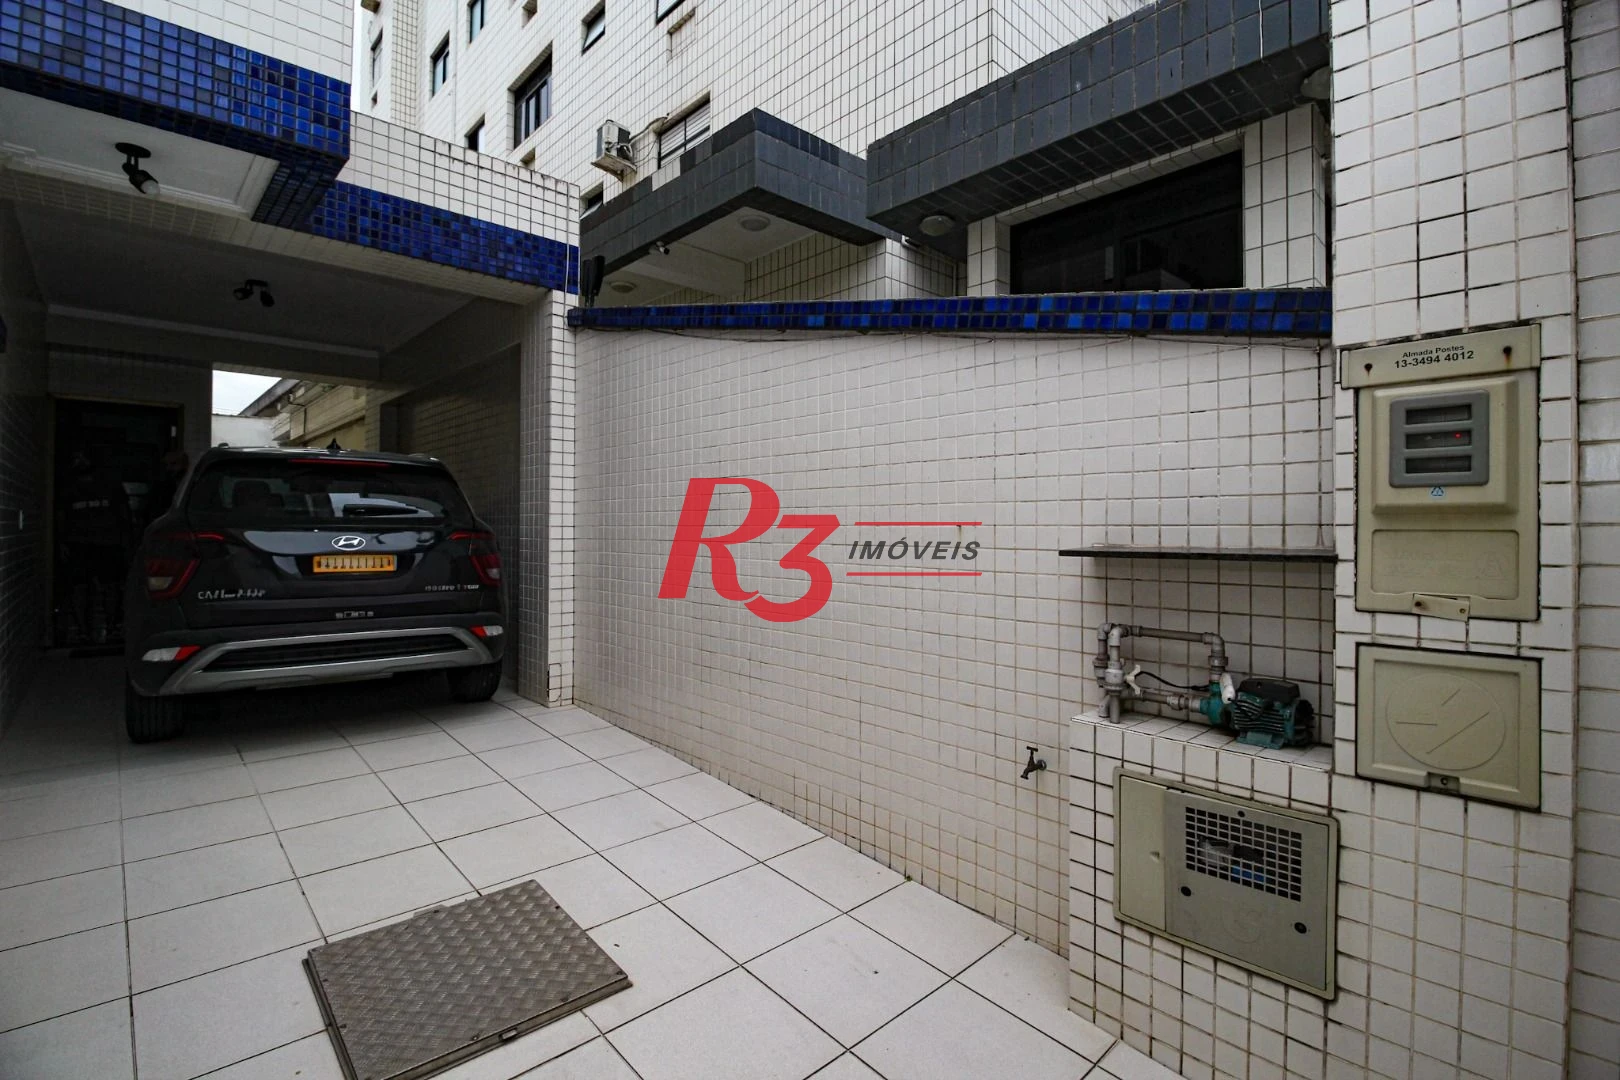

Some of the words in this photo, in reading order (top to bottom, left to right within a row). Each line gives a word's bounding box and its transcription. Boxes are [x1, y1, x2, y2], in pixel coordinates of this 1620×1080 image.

[1394, 356, 1441, 369] 13-3494
[1444, 350, 1474, 362] 4012
[1402, 349, 1433, 358] Almada
[1435, 345, 1465, 354] Postes
